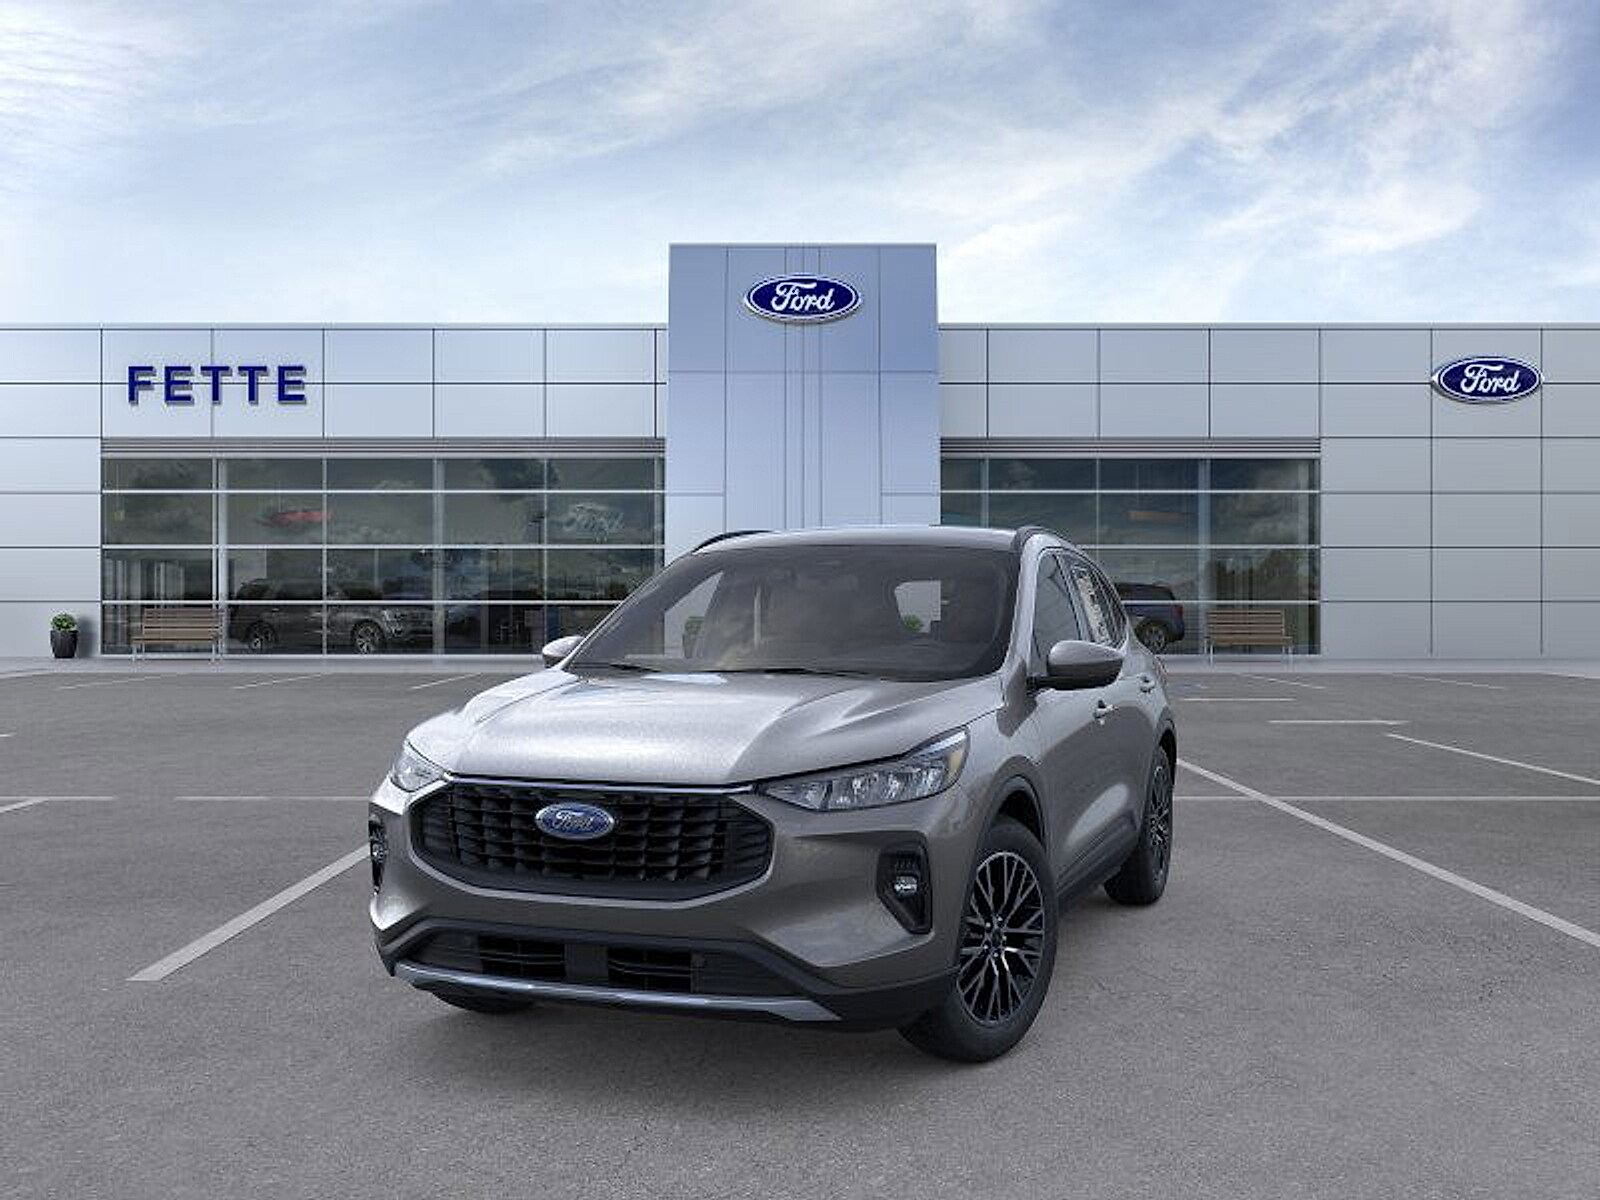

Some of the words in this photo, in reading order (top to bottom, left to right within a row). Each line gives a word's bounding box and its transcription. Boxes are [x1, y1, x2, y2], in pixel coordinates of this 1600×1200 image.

[771, 281, 835, 311] Ford
[128, 366, 305, 402] FETTE
[1460, 364, 1521, 393] Ford
[553, 810, 594, 829] Ford
